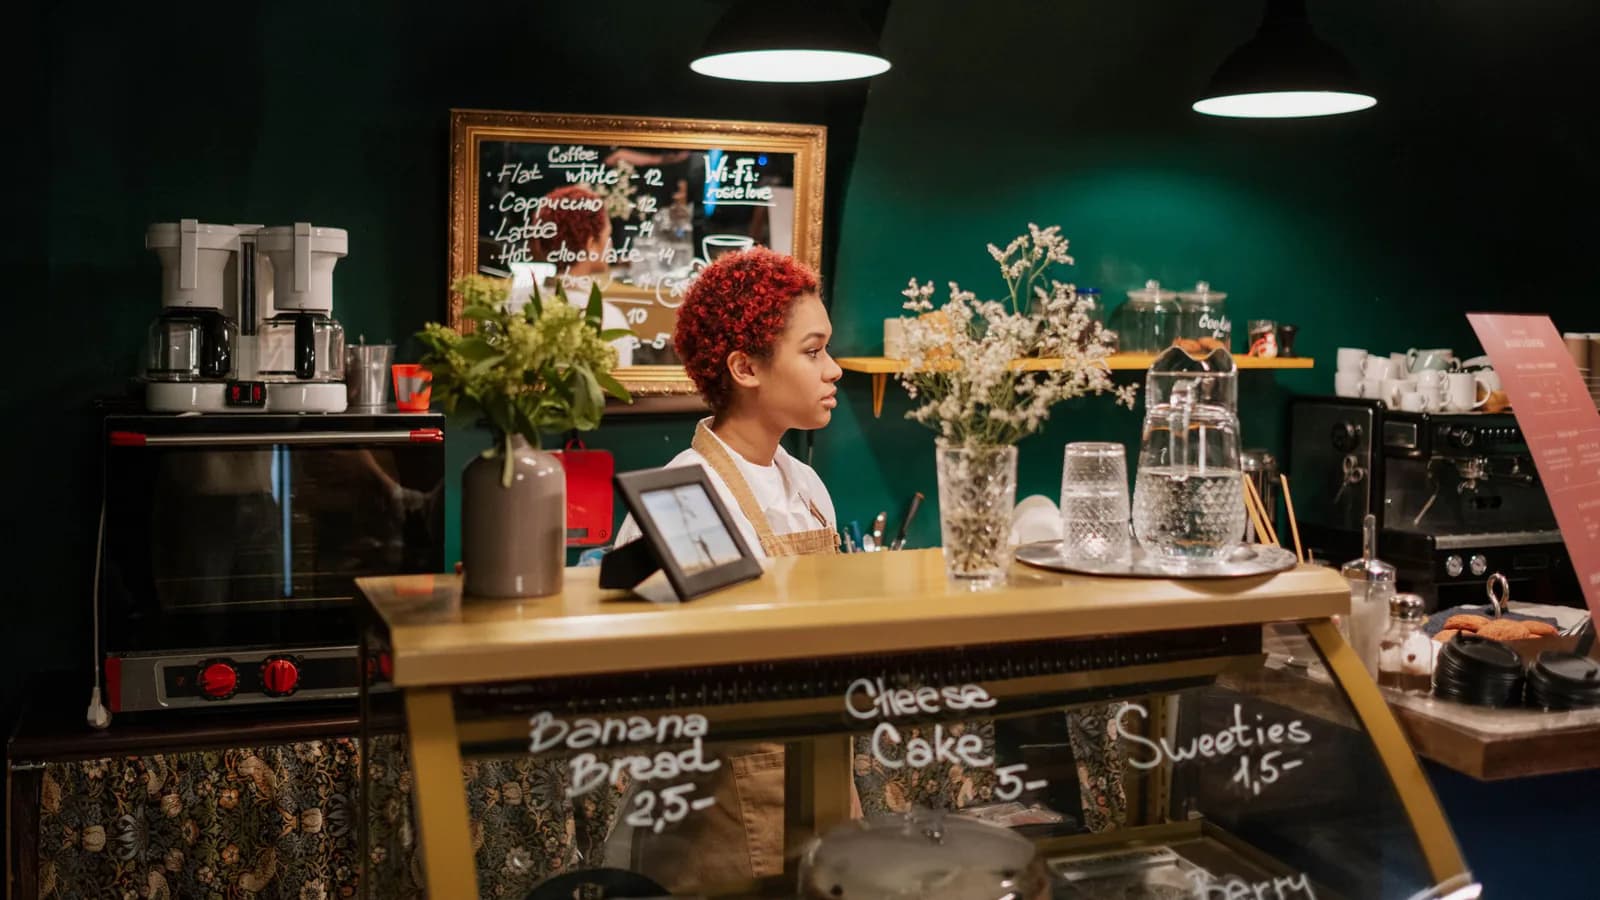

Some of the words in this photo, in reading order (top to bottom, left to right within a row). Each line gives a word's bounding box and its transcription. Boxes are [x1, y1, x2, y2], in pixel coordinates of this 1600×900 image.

[497, 163, 544, 184] Flat
[565, 162, 619, 184] white
[498, 191, 603, 220] Cappuccino
[495, 217, 558, 243] Latte
[498, 240, 533, 265] Hot
[546, 237, 645, 263] chocolate
[627, 308, 648, 324] 10
[845, 676, 998, 719] Cheese
[529, 711, 709, 753] Banana
[872, 722, 994, 768] Cake
[1115, 703, 1312, 769] Sweeties
[565, 736, 721, 798] Bread
